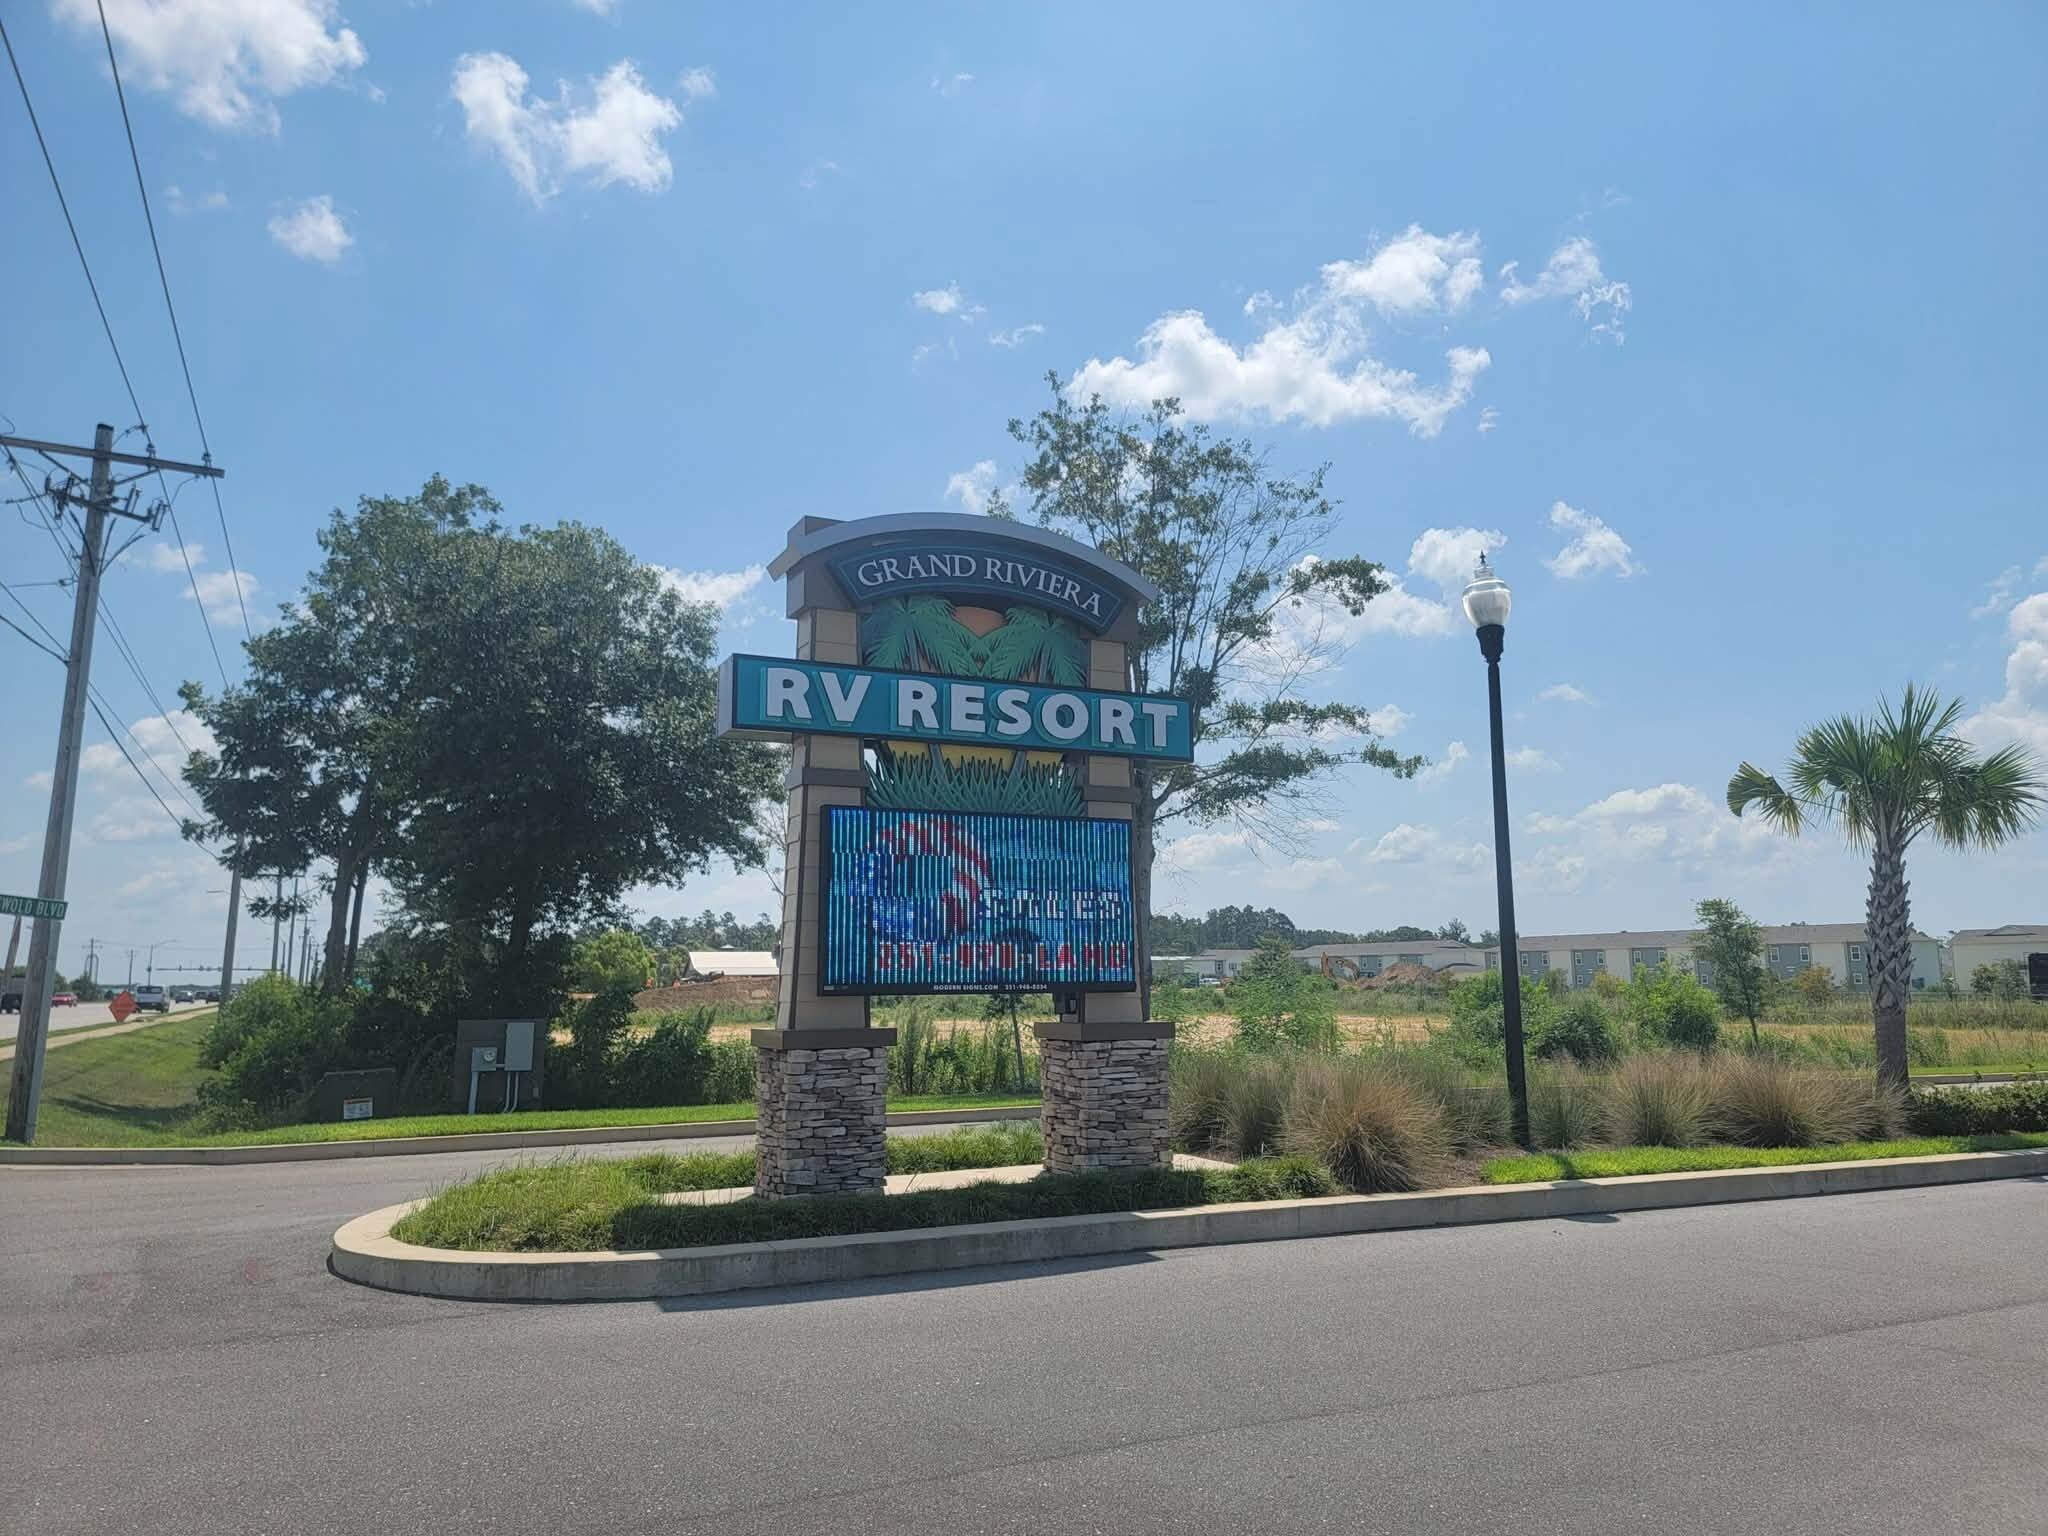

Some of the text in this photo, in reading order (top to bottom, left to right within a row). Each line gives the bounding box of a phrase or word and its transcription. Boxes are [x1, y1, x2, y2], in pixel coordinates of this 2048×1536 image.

[857, 553, 1102, 617] GRAND RIVIERA
[766, 666, 1178, 748] RV RESORT
[36, 901, 65, 918] BLVD
